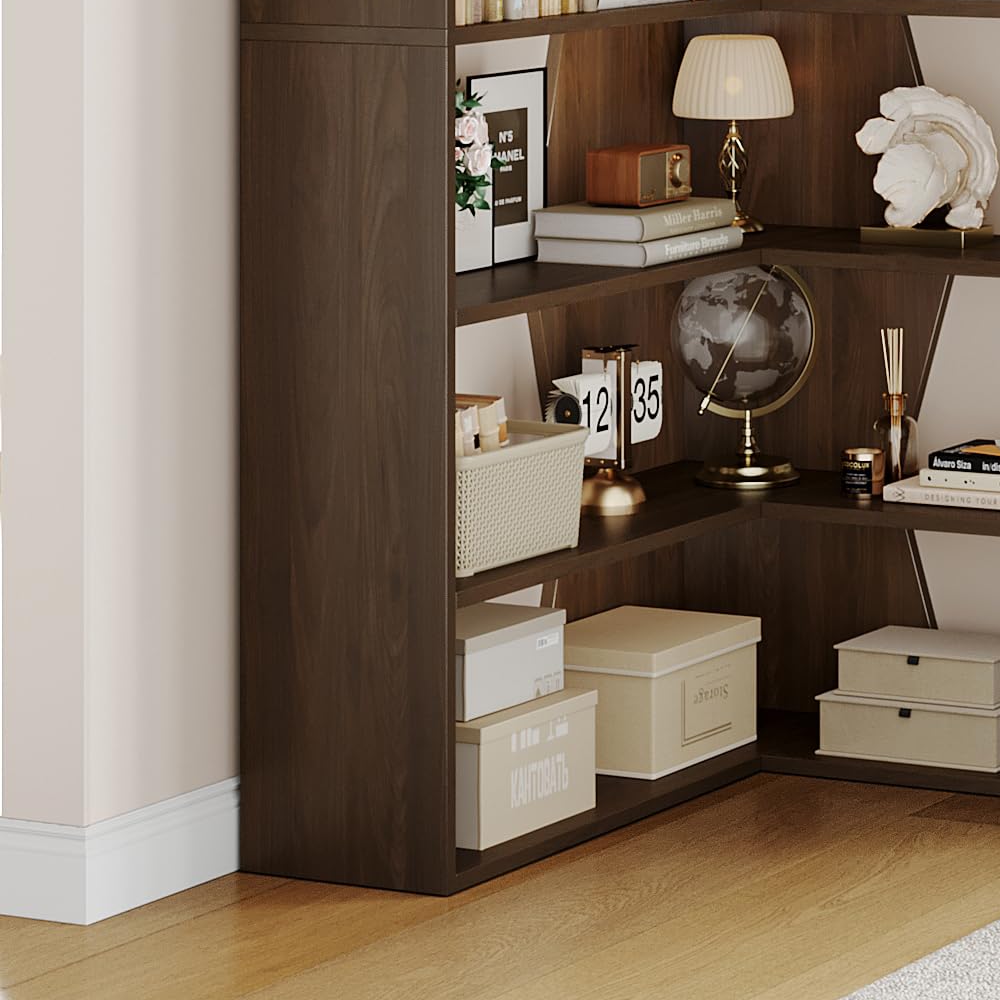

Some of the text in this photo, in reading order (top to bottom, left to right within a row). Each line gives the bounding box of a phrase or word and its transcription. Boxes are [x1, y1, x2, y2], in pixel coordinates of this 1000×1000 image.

[663, 206, 723, 225] Miller Harris
[583, 375, 658, 432] 12 35
[956, 459, 972, 470] Siza
[924, 494, 971, 504] DESIGNING
[976, 497, 998, 506] YOUR
